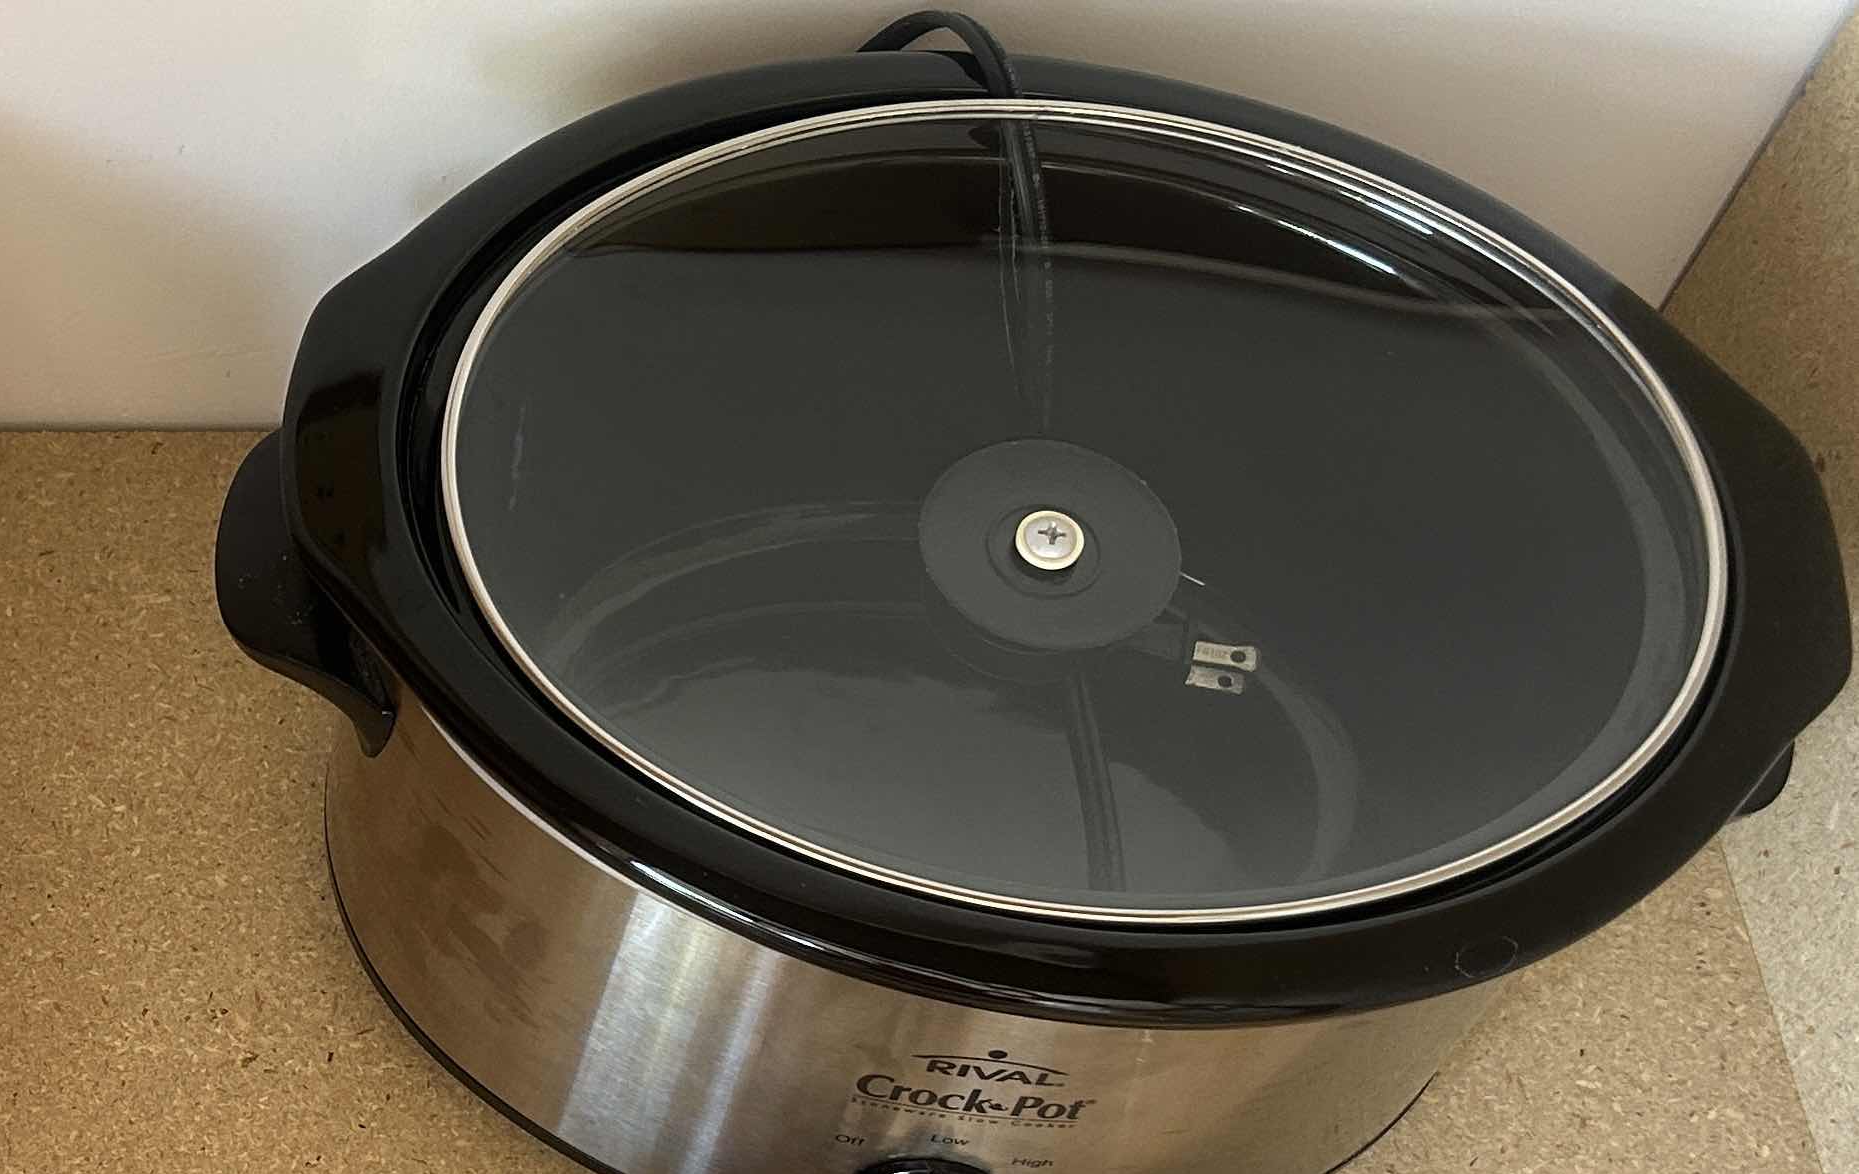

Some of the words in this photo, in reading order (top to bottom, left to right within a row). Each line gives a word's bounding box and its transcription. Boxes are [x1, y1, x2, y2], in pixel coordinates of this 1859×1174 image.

[925, 1057, 1066, 1088] RIVAL
[834, 1133, 867, 1146] Off
[929, 1134, 970, 1146] Low
[1010, 1157, 1054, 1169] High
